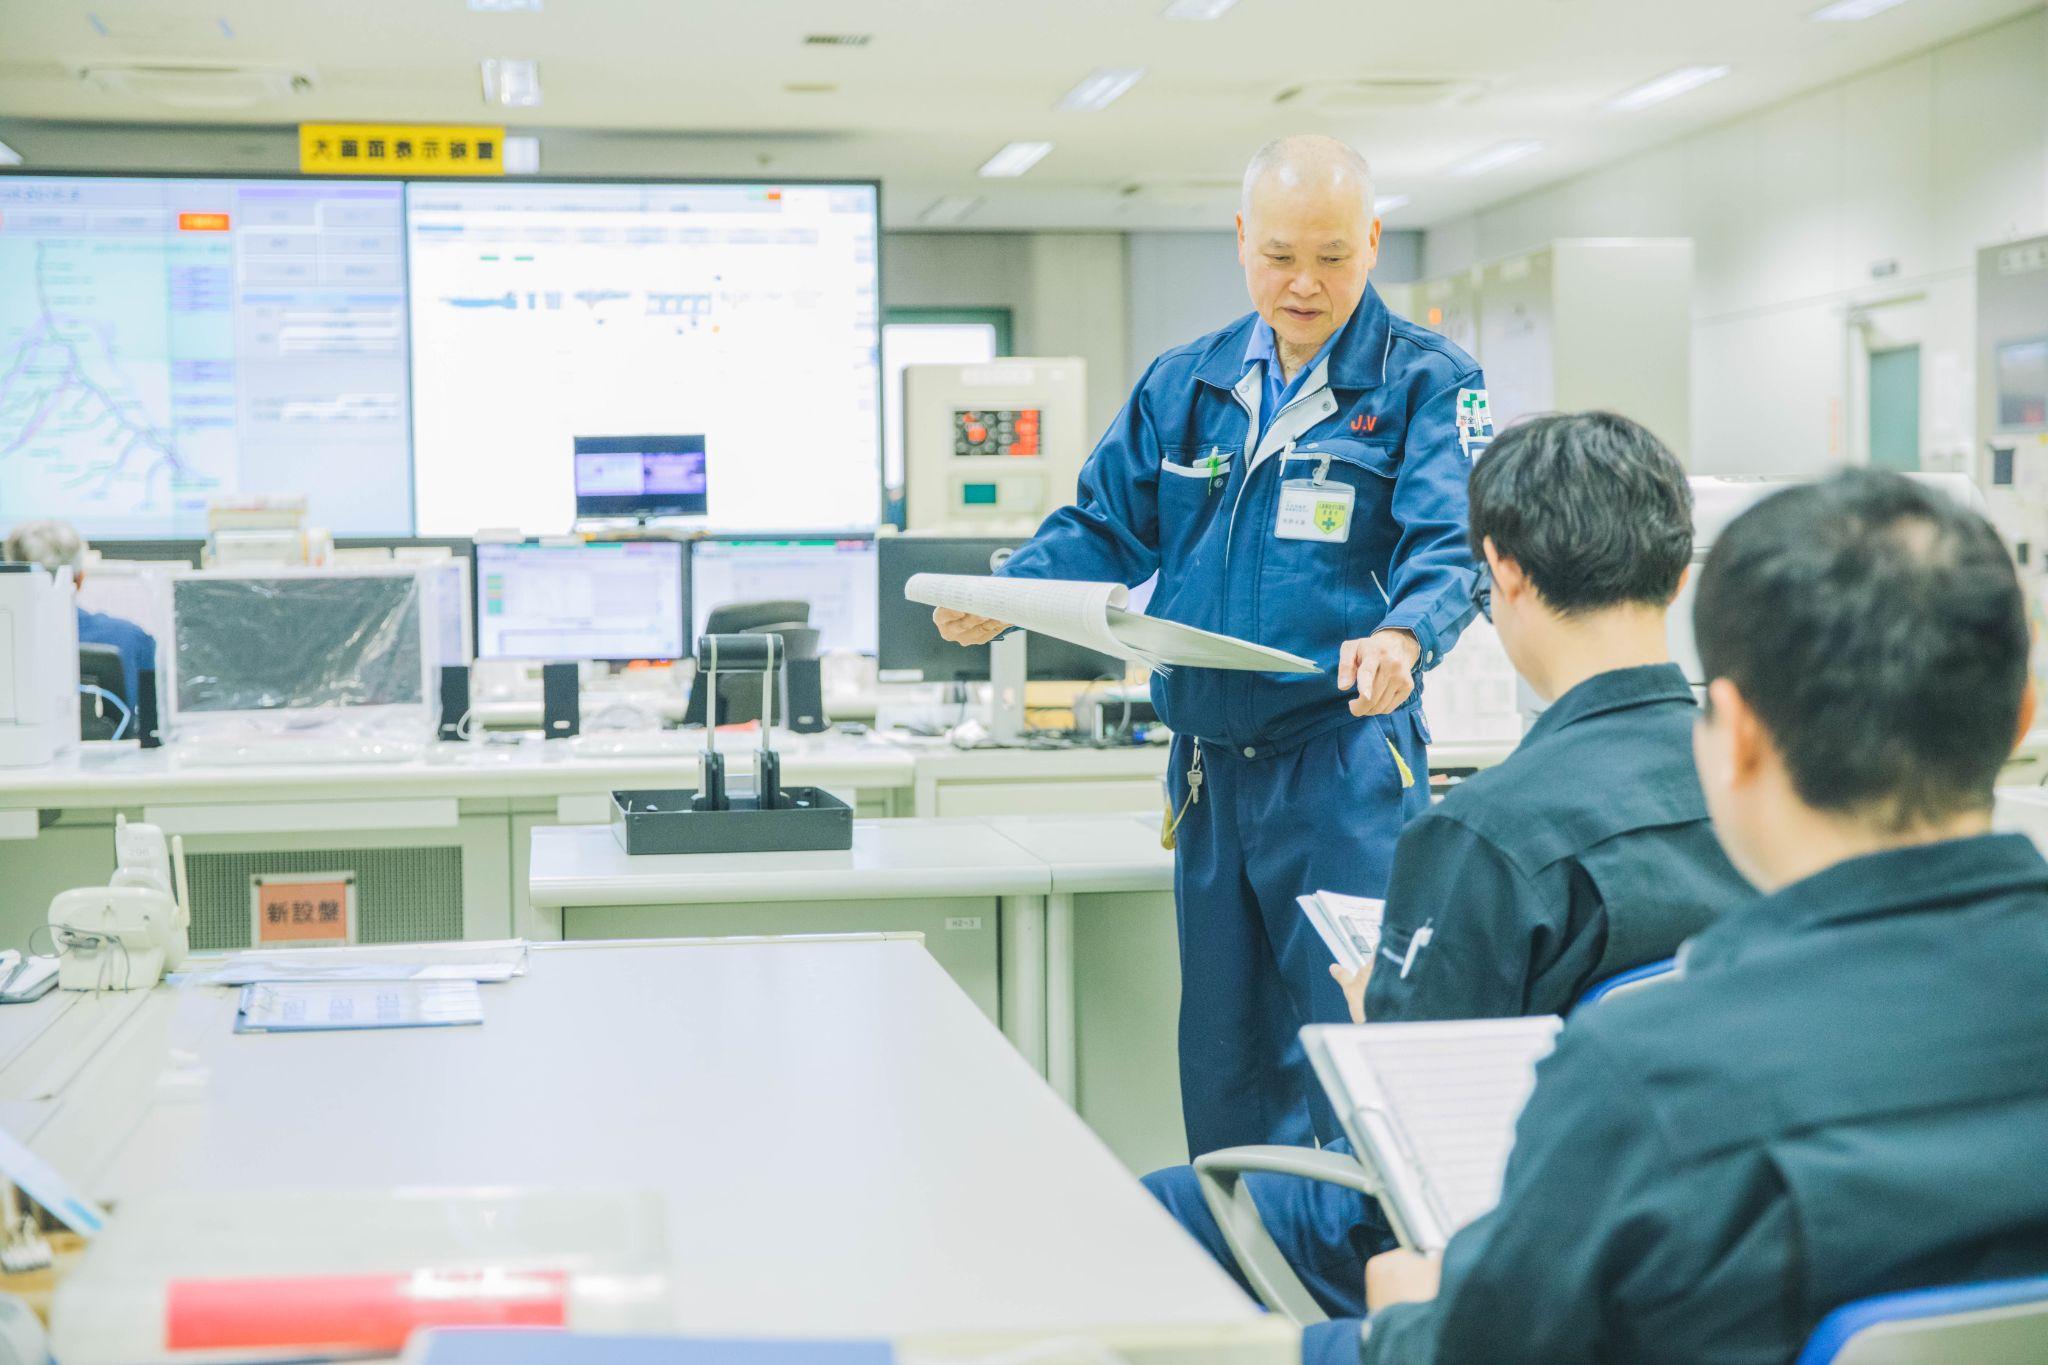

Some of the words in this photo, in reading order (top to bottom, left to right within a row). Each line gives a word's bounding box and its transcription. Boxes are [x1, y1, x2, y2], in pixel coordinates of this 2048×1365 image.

[312, 138, 494, 161] 大画面表示装置
[266, 898, 340, 926] 新設盤
